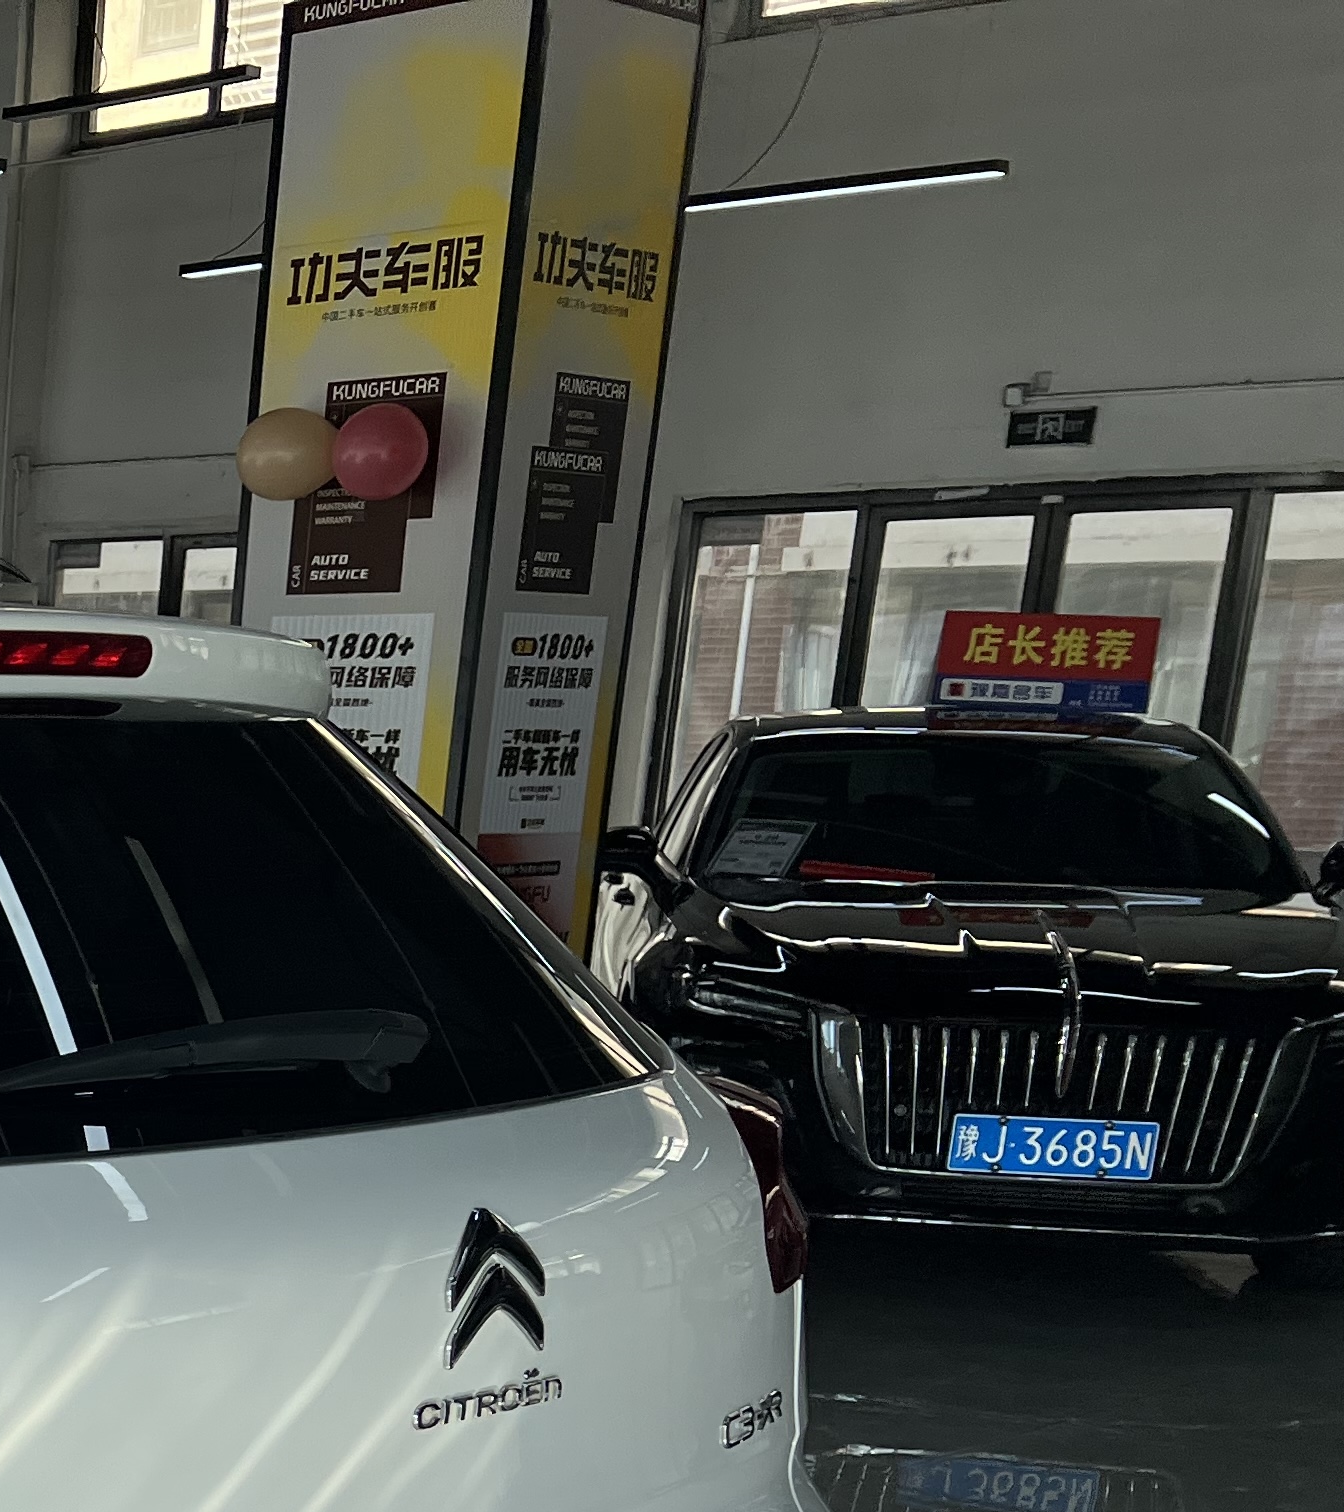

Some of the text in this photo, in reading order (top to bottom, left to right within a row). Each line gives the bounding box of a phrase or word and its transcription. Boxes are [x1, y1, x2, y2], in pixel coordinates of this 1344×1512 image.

[304, 0, 405, 22] KUNGFUC
[286, 235, 484, 305] 功夫车服
[533, 231, 659, 302] 功夫车服
[332, 376, 441, 401] KUNGFUCAR
[557, 376, 627, 400] KUNGFUCAR
[534, 449, 603, 473] KUNGFUCAR
[310, 553, 349, 566] AUTO
[534, 550, 561, 563] AUTO
[291, 565, 302, 588] CAR
[309, 569, 370, 581] SERVICE
[531, 567, 573, 581] SERVICE
[327, 632, 415, 660] 1800+
[538, 633, 594, 660] 1800+
[962, 623, 1136, 670] 店长推荐
[504, 665, 594, 689] 服务网络保障
[498, 746, 579, 777] 用车无忧
[955, 1123, 1153, 1171] 豫J·3685N
[412, 1367, 562, 1430] CITROËN
